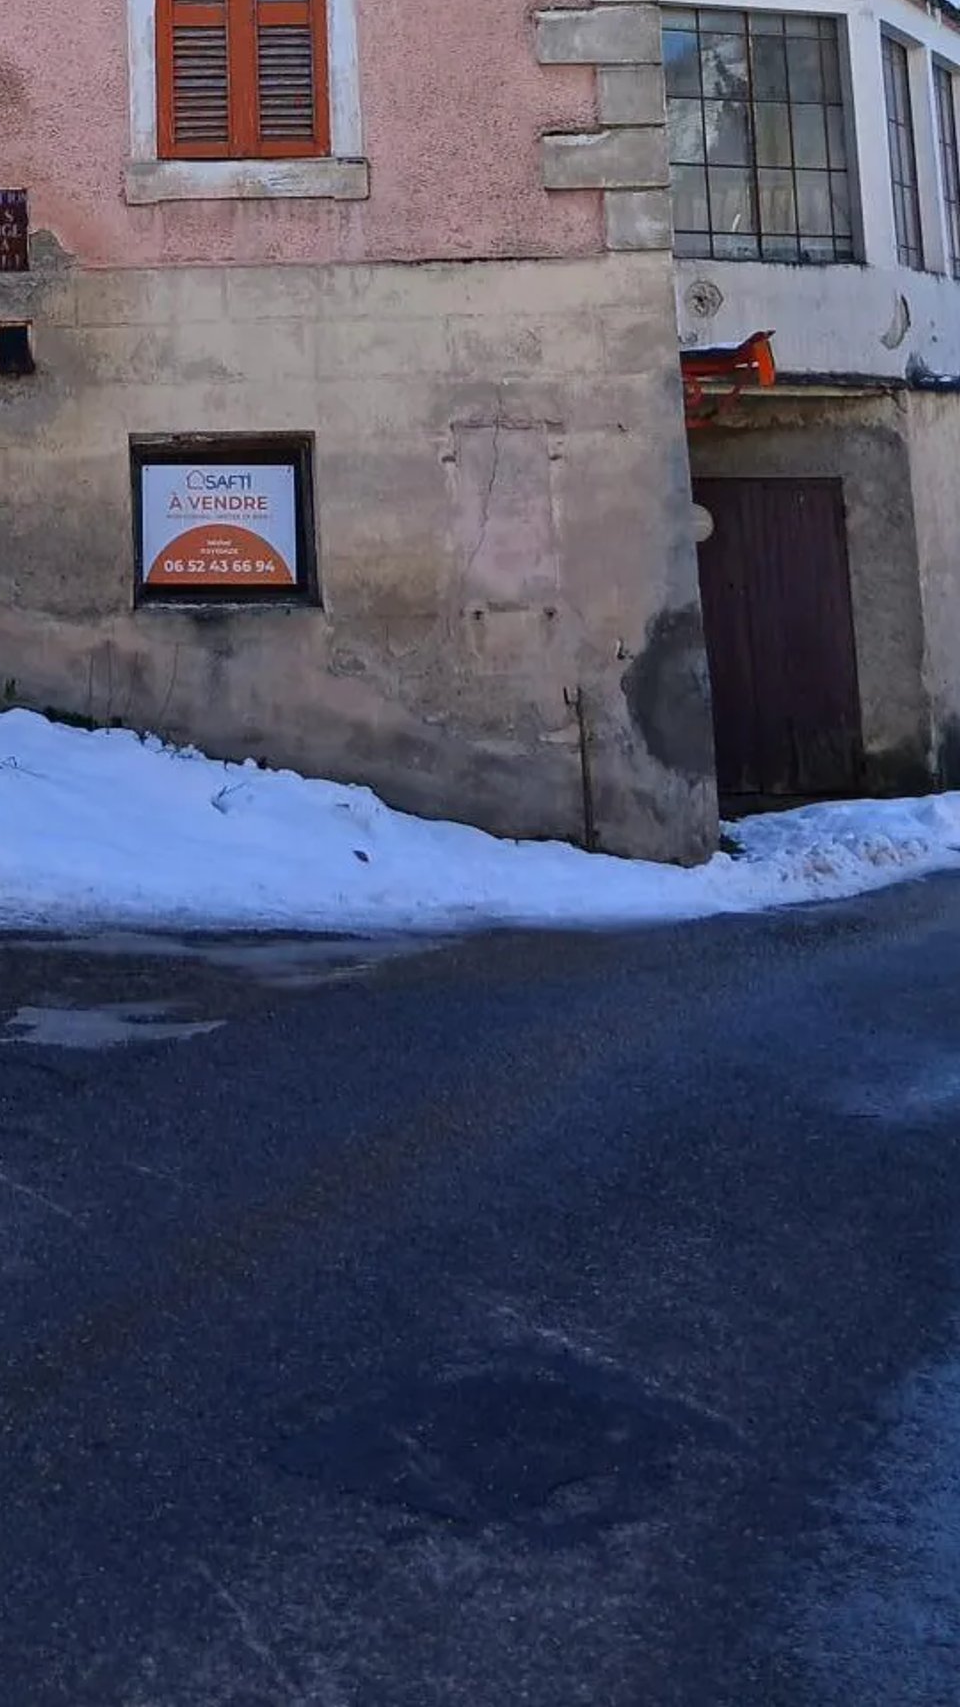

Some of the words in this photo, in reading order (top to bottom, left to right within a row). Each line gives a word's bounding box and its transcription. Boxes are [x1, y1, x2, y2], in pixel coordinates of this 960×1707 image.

[169, 491, 182, 510] À
[188, 496, 268, 510] VENDRE
[164, 560, 184, 572] 06
[187, 560, 206, 572] 52
[209, 560, 228, 572] 43
[233, 560, 251, 572] 66
[255, 560, 275, 572] 94
